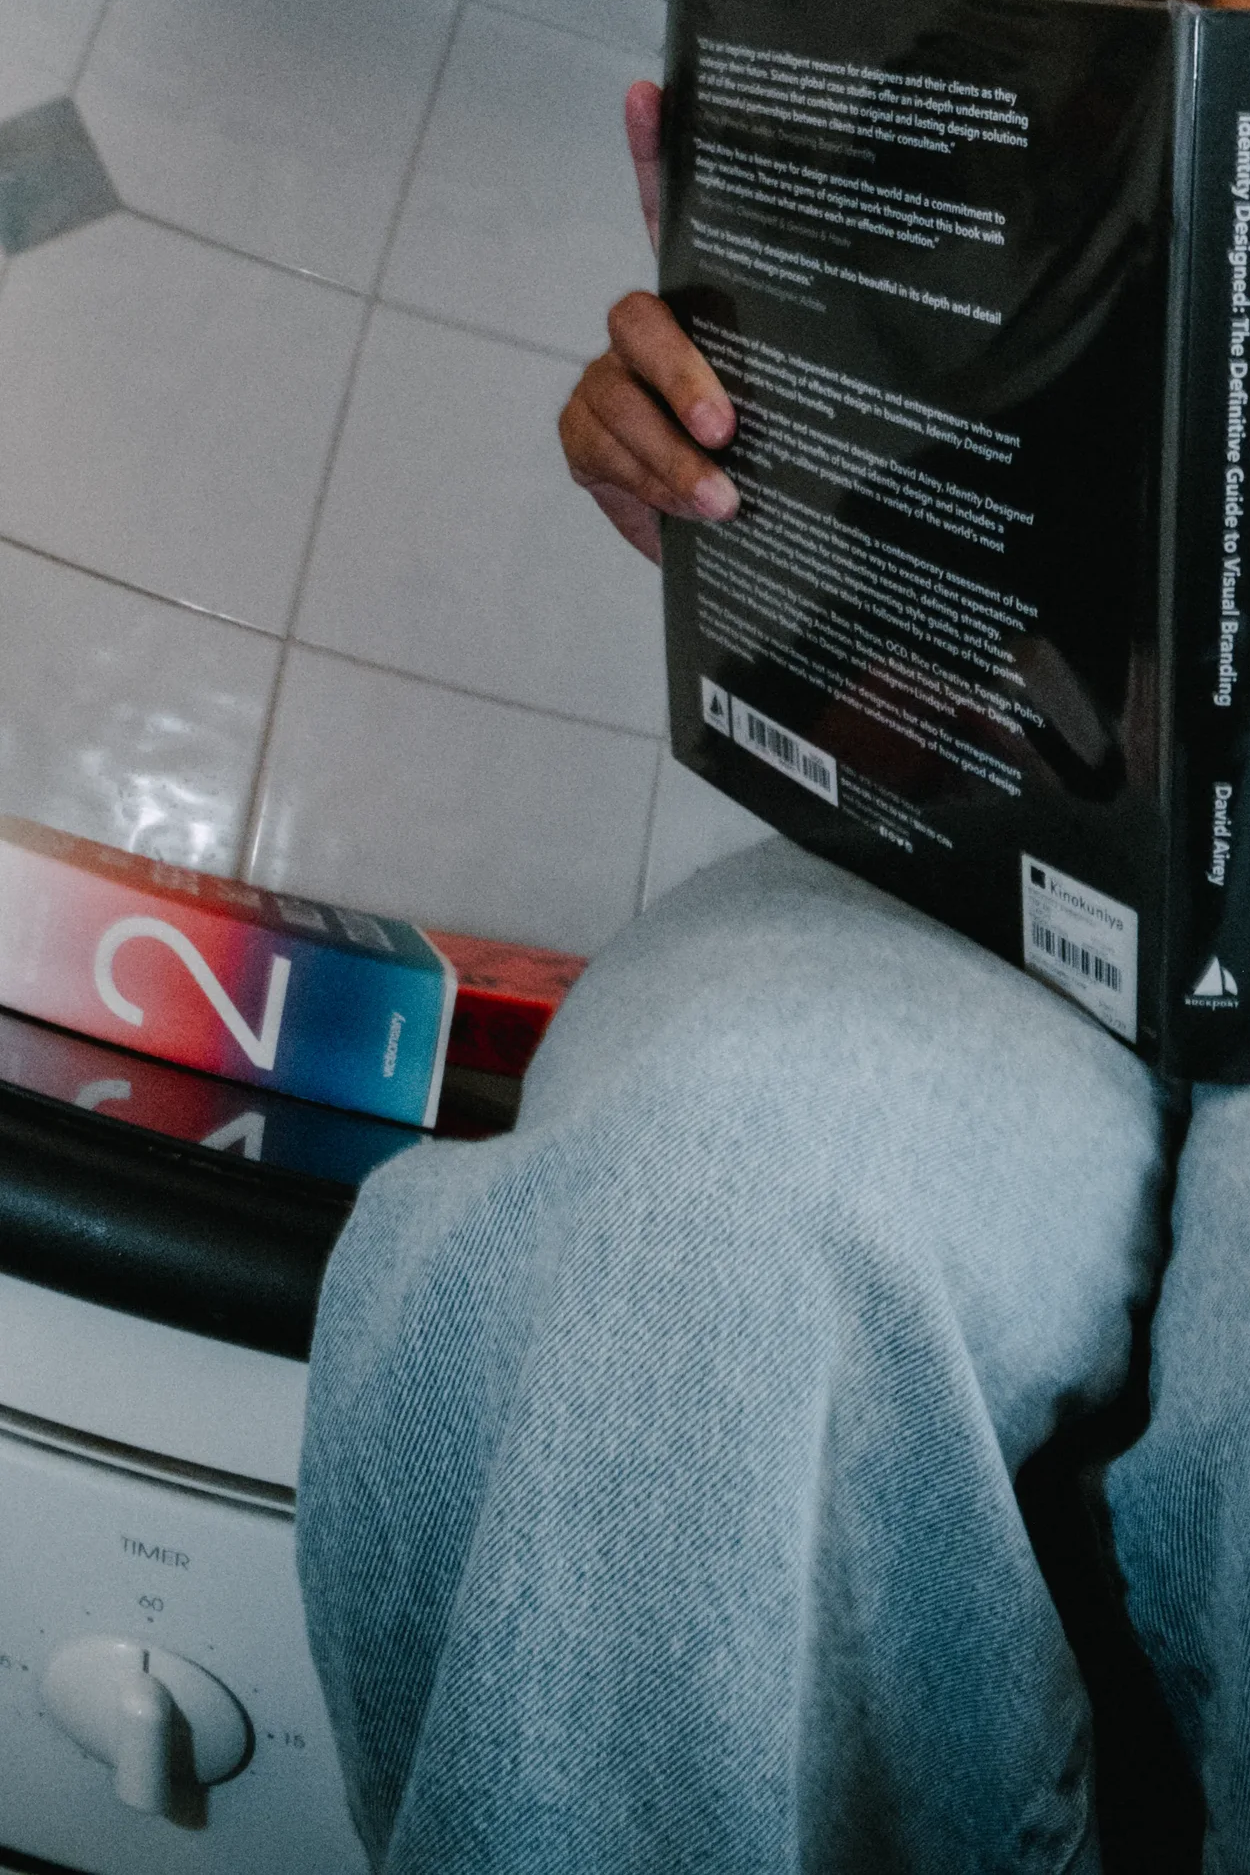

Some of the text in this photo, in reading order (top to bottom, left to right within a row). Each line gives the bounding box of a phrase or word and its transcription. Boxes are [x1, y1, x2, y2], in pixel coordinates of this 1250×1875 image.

[811, 61, 845, 74] resource
[846, 64, 858, 76] for
[860, 66, 902, 84] designers
[904, 75, 922, 87] and
[924, 77, 946, 90] their
[948, 81, 978, 96] clients
[981, 89, 992, 98] as
[994, 89, 1016, 105] they
[826, 82, 844, 93] case
[846, 85, 876, 99] studies
[878, 90, 898, 103] offer
[900, 95, 912, 105] an
[914, 95, 952, 114] in-depth
[956, 104, 1028, 128] understanding
[806, 97, 848, 112] contribute
[849, 104, 858, 114] to
[860, 106, 892, 122] original
[894, 114, 912, 125] and
[914, 115, 944, 135] lasting
[947, 121, 979, 140] design
[982, 130, 1028, 146] solutions
[828, 118, 854, 133] clients
[856, 125, 872, 137] and
[874, 127, 895, 141] their
[801, 165, 828, 184] design
[830, 175, 858, 189] around
[860, 180, 874, 193] the
[876, 186, 901, 200] world
[904, 193, 921, 204] and
[924, 198, 928, 206] a
[931, 199, 992, 221] commitment
[994, 213, 1005, 224] to
[816, 189, 825, 200] of
[826, 192, 858, 208] original
[860, 201, 881, 214] work
[884, 206, 933, 227] throughout
[936, 219, 952, 232] this
[955, 222, 979, 238] book
[982, 231, 1004, 244] with
[824, 211, 843, 223] each
[845, 216, 856, 227] an
[858, 218, 894, 237] effective
[824, 262, 838, 276] but
[840, 268, 856, 281] also
[858, 272, 896, 294] beautiful
[898, 284, 906, 297] in
[909, 287, 919, 300] its
[922, 291, 949, 310] depth
[952, 303, 970, 315] and
[972, 306, 1000, 324] detail
[1230, 317, 1250, 357] The
[840, 373, 882, 400] designers,
[884, 392, 901, 405] and
[904, 399, 968, 429] entrepreneurs
[970, 423, 992, 437] who
[994, 431, 1020, 447] want
[844, 392, 1012, 464] design in business, Identity Designed
[1226, 360, 1249, 463] Definitive
[850, 443, 1034, 525] designer David Airey, Identity Designed
[868, 468, 900, 495] identity
[902, 482, 932, 506] design
[935, 499, 952, 513] and
[956, 504, 995, 530] includes
[998, 524, 1004, 534] a
[1224, 466, 1245, 528] Guide
[853, 479, 1004, 552] from a variety of the world’s most
[1223, 533, 1241, 554] to
[868, 553, 1025, 631] way to exceed client expectations.
[874, 538, 1037, 617] a contemporary assessment of best
[1221, 557, 1242, 616] Visual
[872, 603, 910, 631] followed
[912, 622, 922, 641] by
[926, 632, 930, 641] a
[933, 636, 958, 658] recap
[961, 649, 970, 661] of
[973, 652, 990, 673] key
[879, 575, 1001, 643] research, defining strategy,
[928, 616, 960, 640] guides,
[964, 633, 981, 648] and
[886, 638, 1046, 728] OCD, Rice Creative, Foreign Policy,
[1213, 620, 1239, 707] Branding
[944, 684, 985, 715] Together
[920, 720, 937, 736] also
[940, 727, 952, 744] for
[954, 738, 1020, 780] entrepreneurs
[960, 758, 985, 778] good
[988, 770, 1020, 797] design
[1206, 783, 1233, 887] David Airey
[1050, 878, 1124, 931] Kinokuniya
[95, 913, 292, 1072] 2
[1184, 997, 1239, 1011] ROCKPORT
[120, 1536, 190, 1571] TIMER
[138, 1595, 165, 1613] 60
